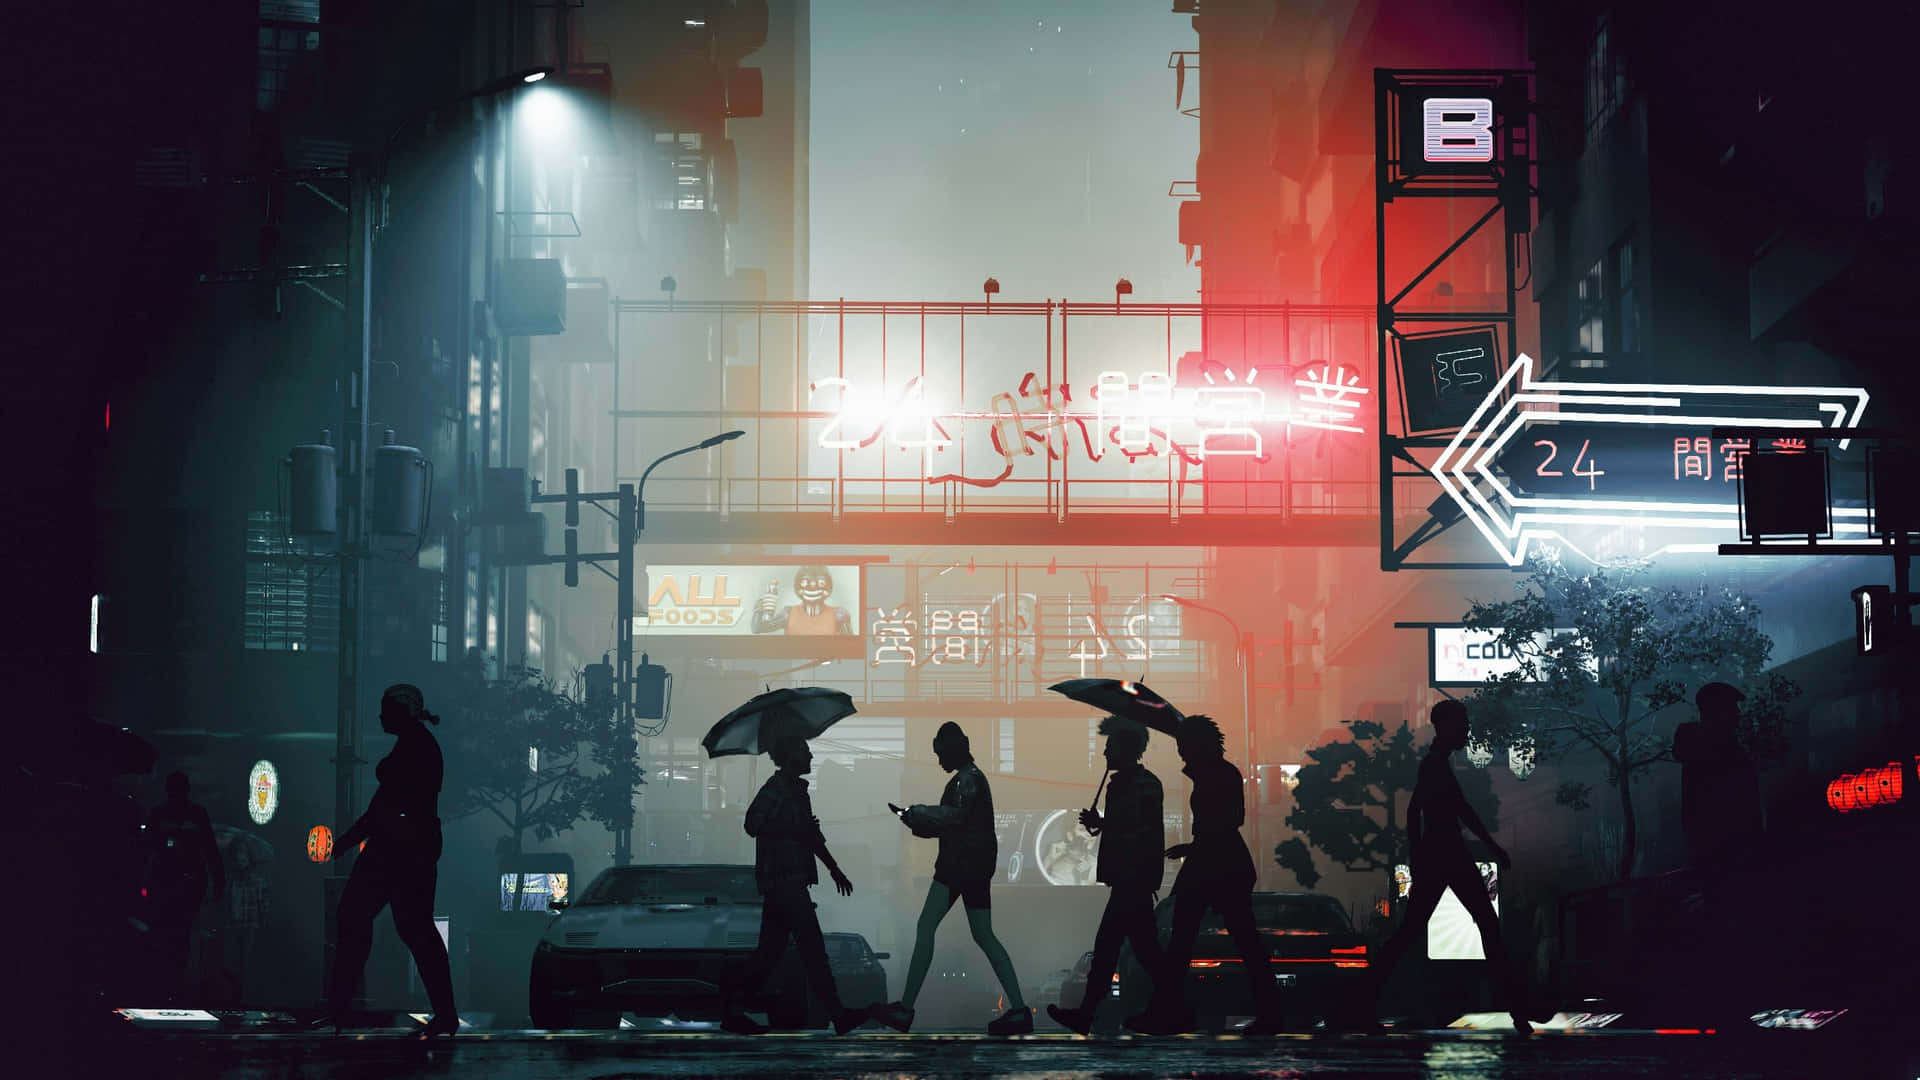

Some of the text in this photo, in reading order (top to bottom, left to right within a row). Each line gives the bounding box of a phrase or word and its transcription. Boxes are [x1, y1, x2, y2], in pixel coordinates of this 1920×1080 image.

[1423, 98, 1493, 162] B
[1534, 439, 1605, 491] 24
[649, 575, 741, 606] ALL
[648, 608, 735, 625] FOODS
